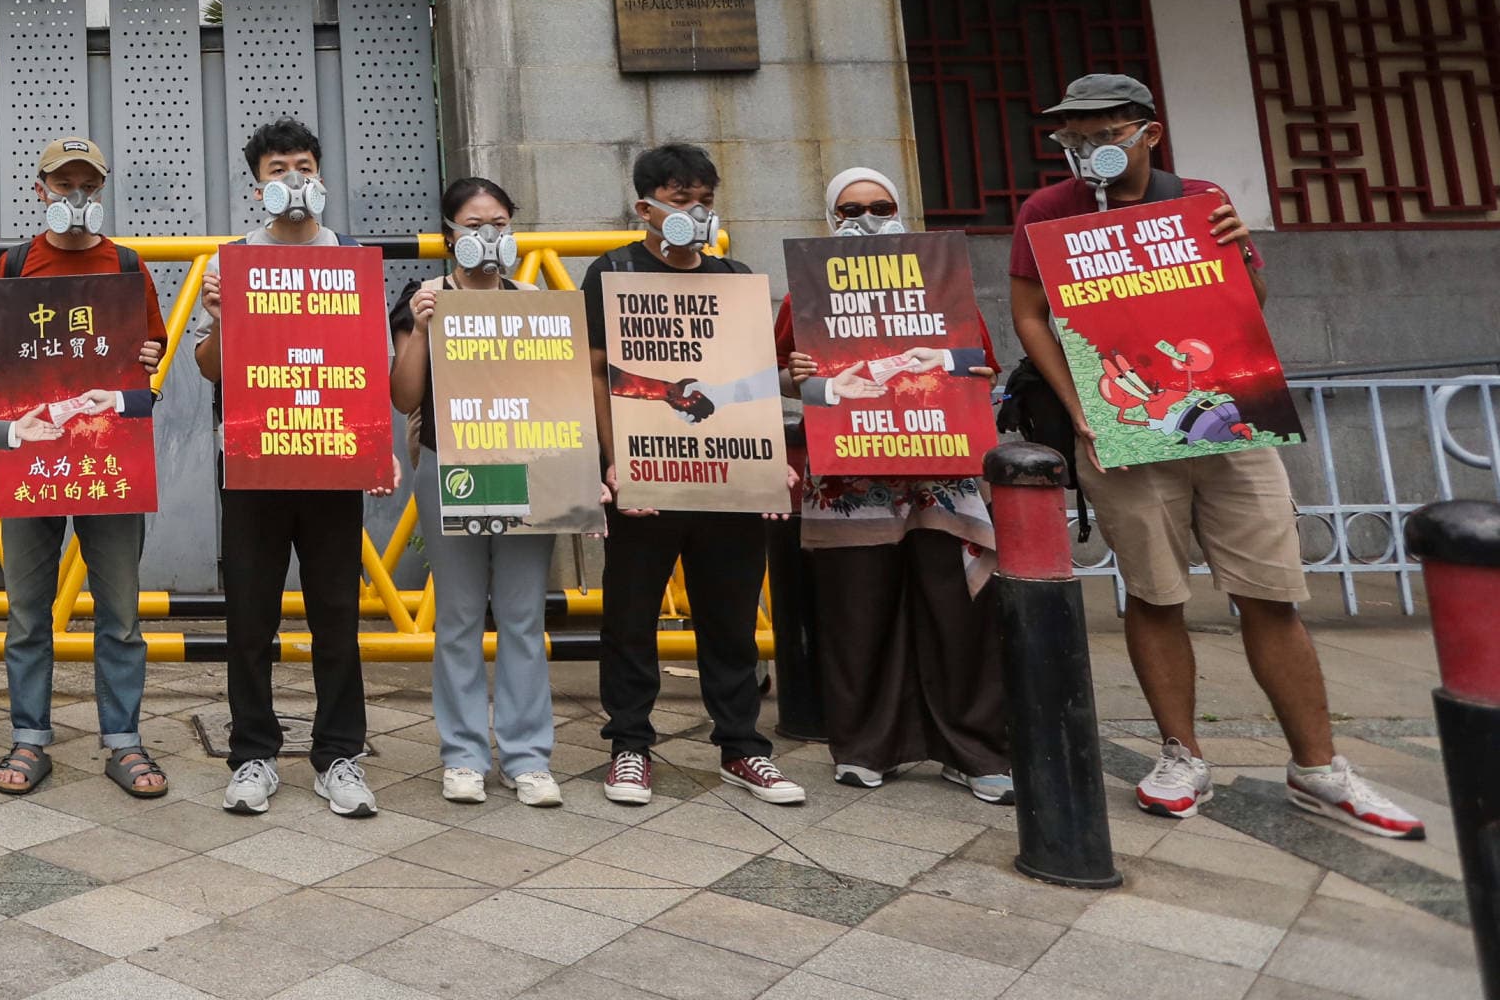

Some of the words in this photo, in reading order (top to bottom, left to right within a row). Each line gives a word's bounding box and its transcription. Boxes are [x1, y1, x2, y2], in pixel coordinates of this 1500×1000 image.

[1064, 224, 1127, 256] DON'T
[1132, 214, 1186, 244] JUST
[1066, 249, 1144, 281] TRADE,
[1143, 238, 1201, 268] TAKE
[249, 268, 304, 291] CLEAN
[309, 269, 356, 291] YOUR
[826, 253, 925, 291] CHINA
[1058, 259, 1225, 308] RESPONSIBILITY
[246, 292, 302, 315] TRADE
[307, 292, 360, 315] CHAIN
[616, 294, 668, 315] TOXIC
[674, 294, 719, 316] HAZE
[830, 291, 887, 315] DON'T
[892, 290, 926, 312] LET
[29, 303, 94, 338] 中国
[444, 316, 497, 337] CLEAN
[501, 316, 523, 337] UP
[527, 316, 571, 337] YOUR
[620, 317, 684, 339] KNOWS
[690, 318, 714, 339] NO
[823, 316, 877, 339] YOUR
[881, 313, 946, 336] TRADE
[18, 336, 109, 359] 别让贸易
[288, 348, 323, 364] FROM
[446, 339, 509, 360] SUPPLY
[513, 339, 574, 360] CHAINS
[622, 340, 702, 362] BORDERS
[247, 366, 313, 389] FOREST
[317, 367, 366, 389] FIRES
[295, 390, 320, 406] AND
[450, 398, 483, 421] NOT
[488, 398, 529, 421] JUST
[266, 407, 344, 431] CLIMATE
[850, 410, 899, 433] FUEL
[904, 409, 946, 432] OUR
[261, 432, 357, 456] DISASTERS
[452, 422, 508, 450] YOUR
[514, 421, 583, 449] IMAGE
[628, 435, 699, 459] NEITHER
[705, 437, 773, 460] SHOULD
[834, 434, 970, 458] SUFFOCATION
[28, 454, 122, 478] 成为窒息
[630, 459, 729, 484] SOLIDARITY
[14, 478, 131, 503] 我们的推手
